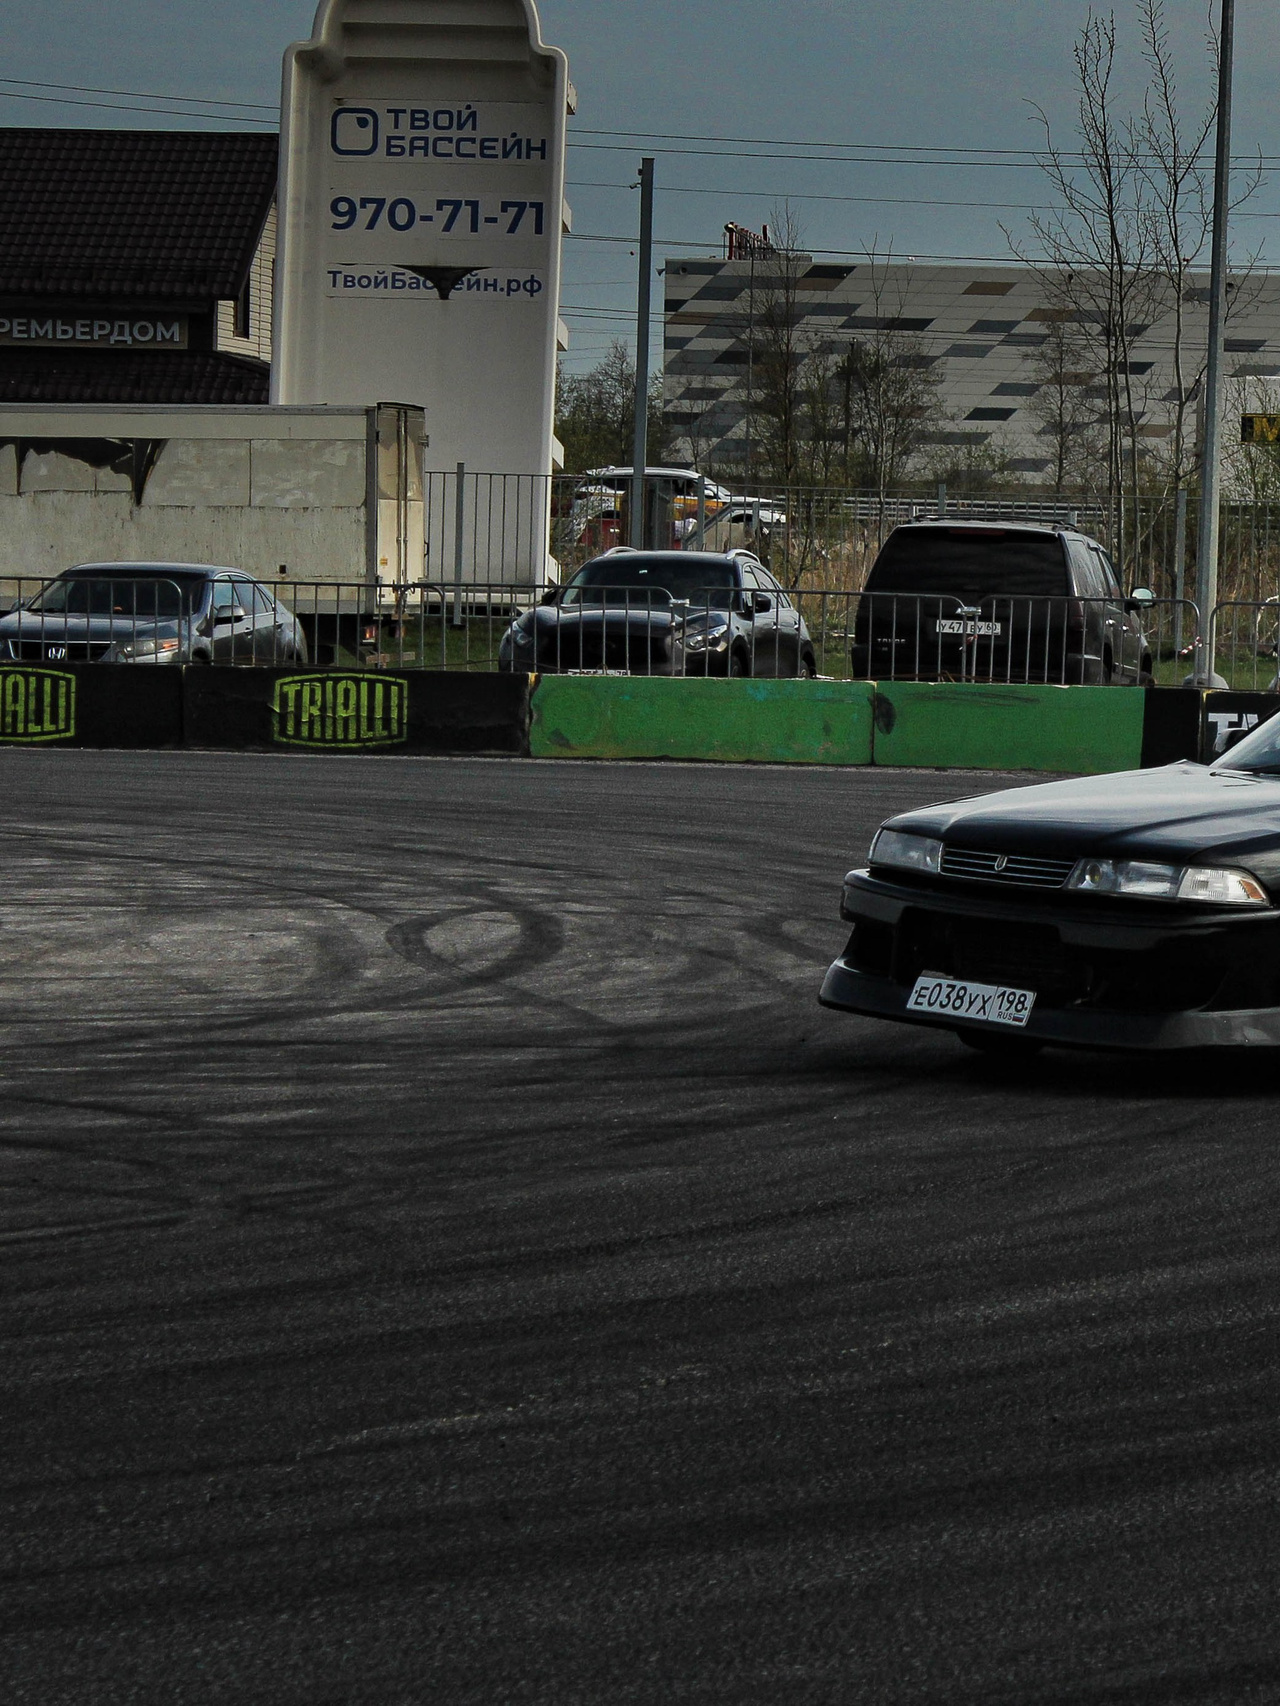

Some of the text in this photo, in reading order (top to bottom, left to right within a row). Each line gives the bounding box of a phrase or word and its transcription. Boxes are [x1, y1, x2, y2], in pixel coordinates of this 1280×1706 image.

[386, 104, 477, 131] ТВОЙ
[385, 132, 546, 160] БАССЕЙН
[330, 196, 544, 235] 970-71-71
[327, 270, 542, 298] ТвойБасейн.рф
[281, 679, 400, 740] TRIALLI
[996, 989, 1029, 1013] 198
[996, 1011, 1014, 1021] RUS
